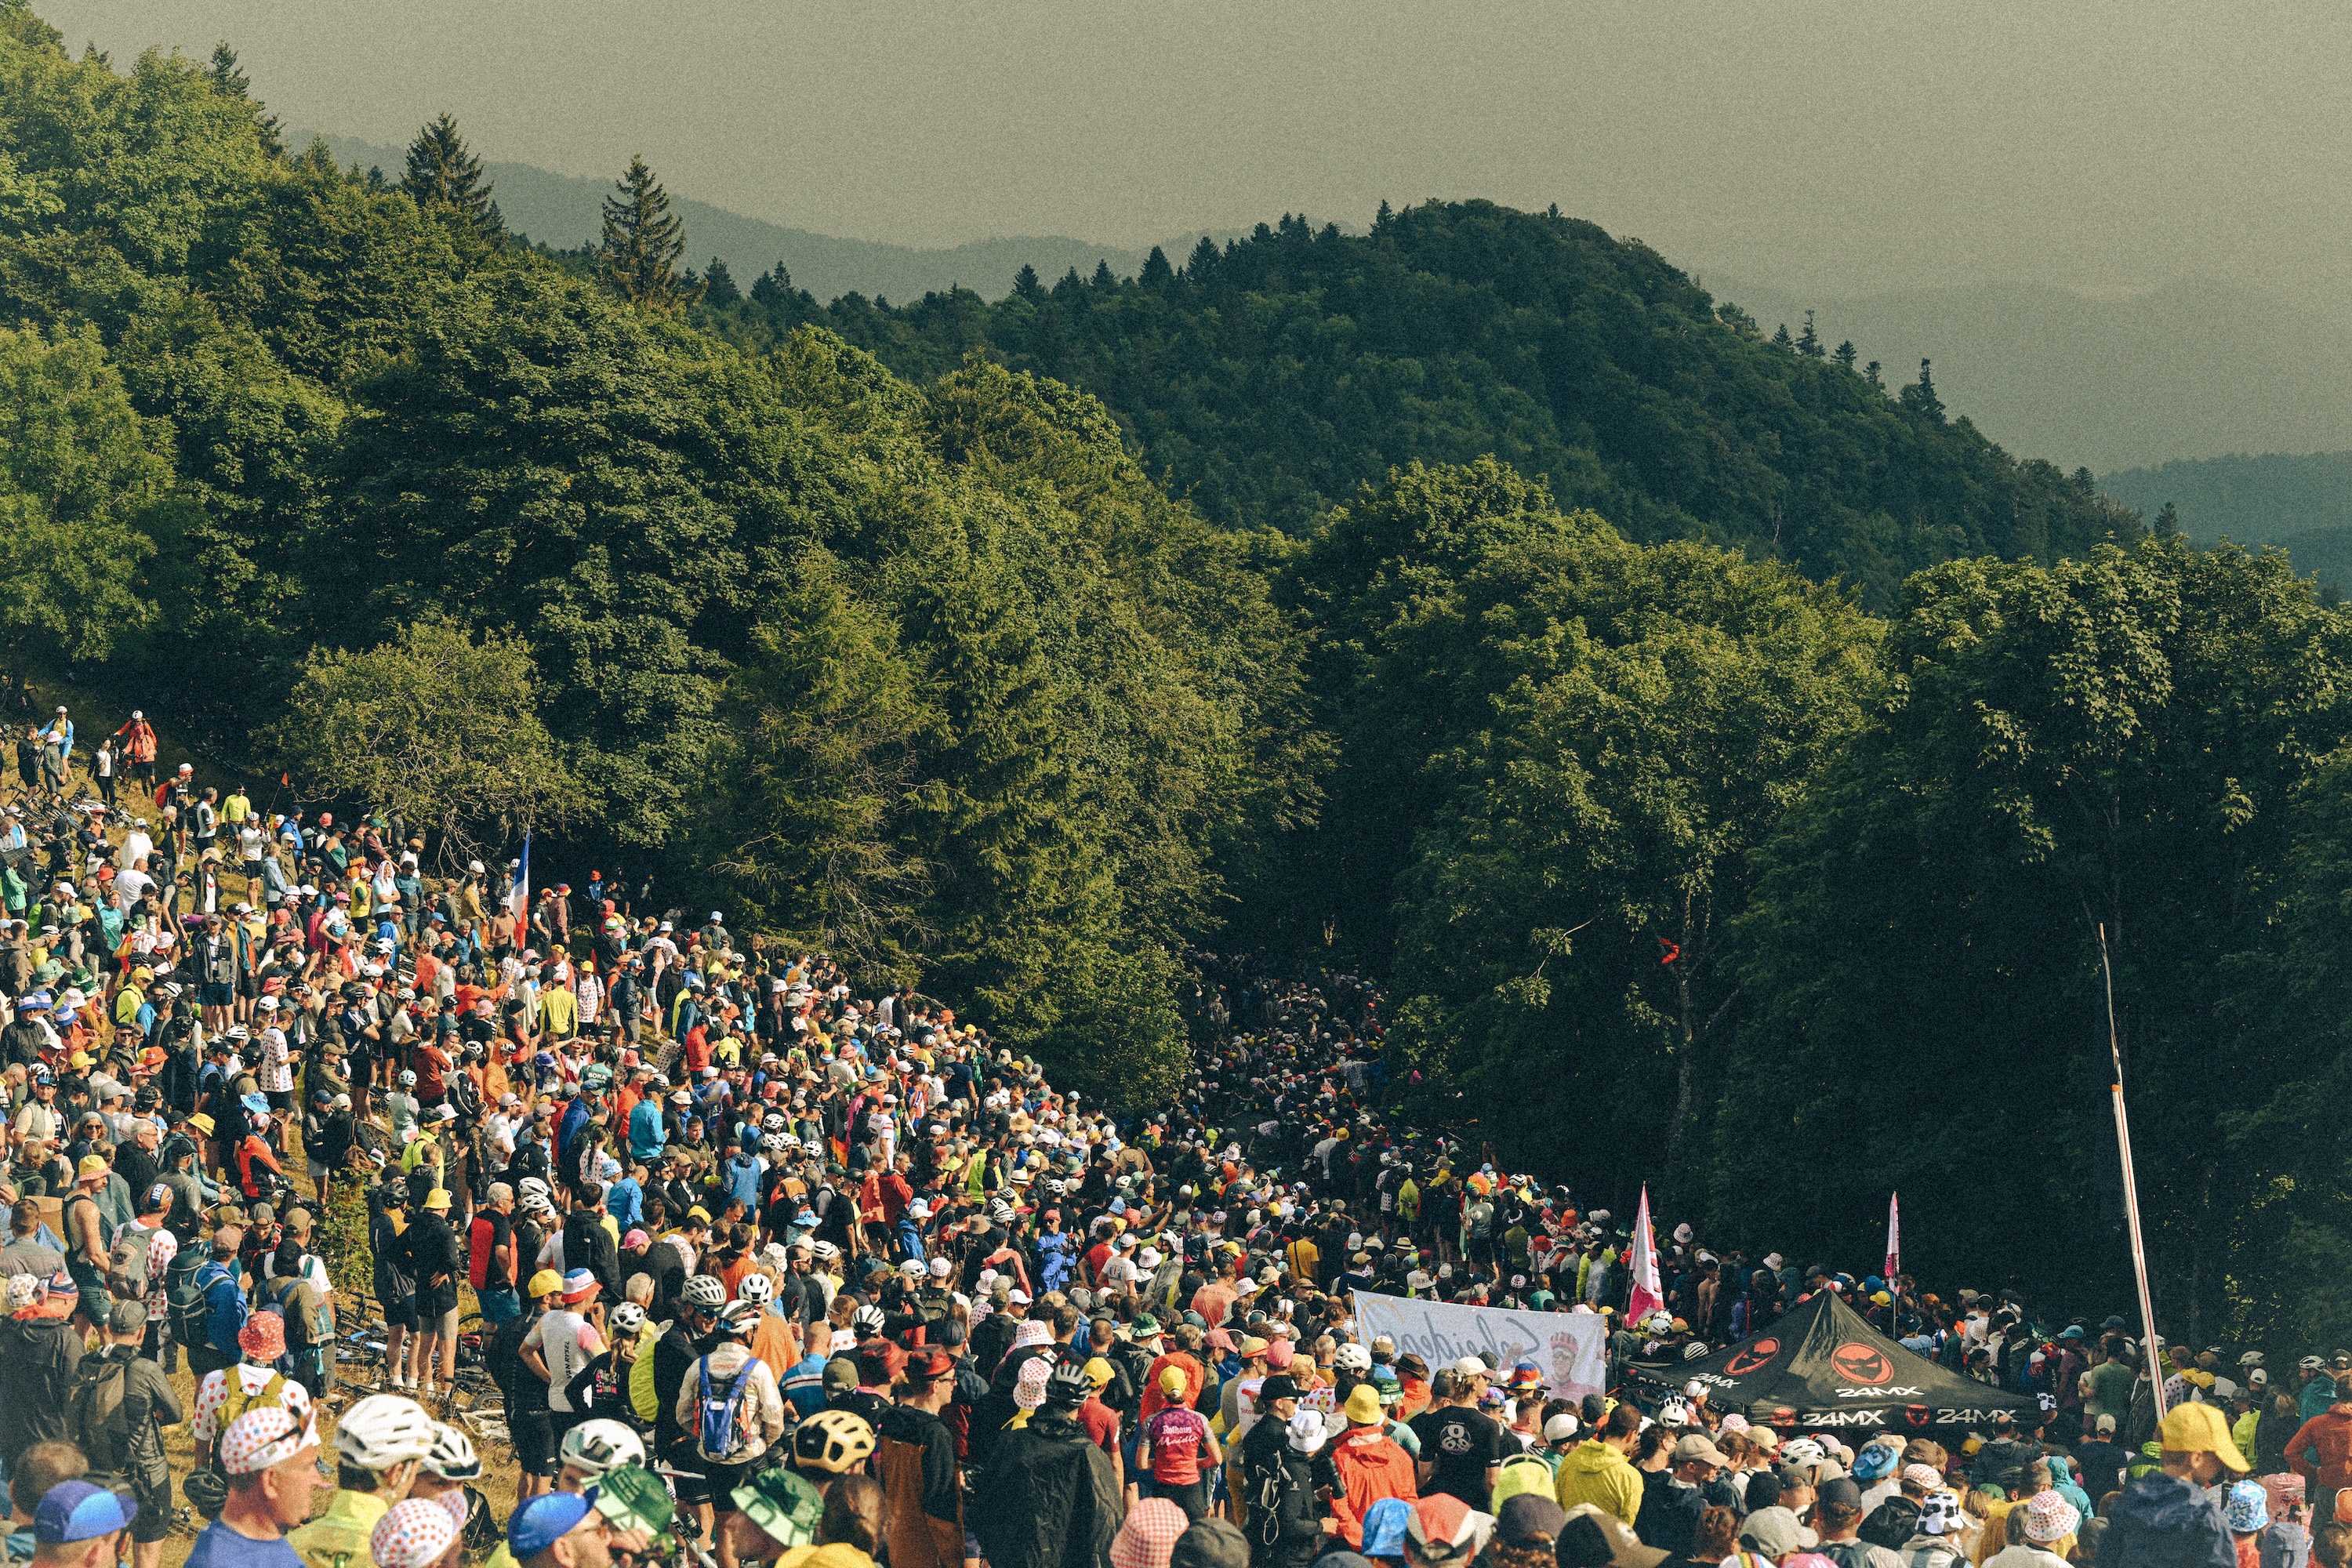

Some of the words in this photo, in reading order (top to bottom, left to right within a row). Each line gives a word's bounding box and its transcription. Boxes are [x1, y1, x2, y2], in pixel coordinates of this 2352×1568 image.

[588, 1072, 607, 1080] BORA
[1690, 1373, 1741, 1389] 24MX
[1835, 1386, 1926, 1398] 24MX
[1802, 1409, 1886, 1427] 24MX
[1935, 1408, 2019, 1424] 24MX
[1162, 1425, 1192, 1437] Rothaus
